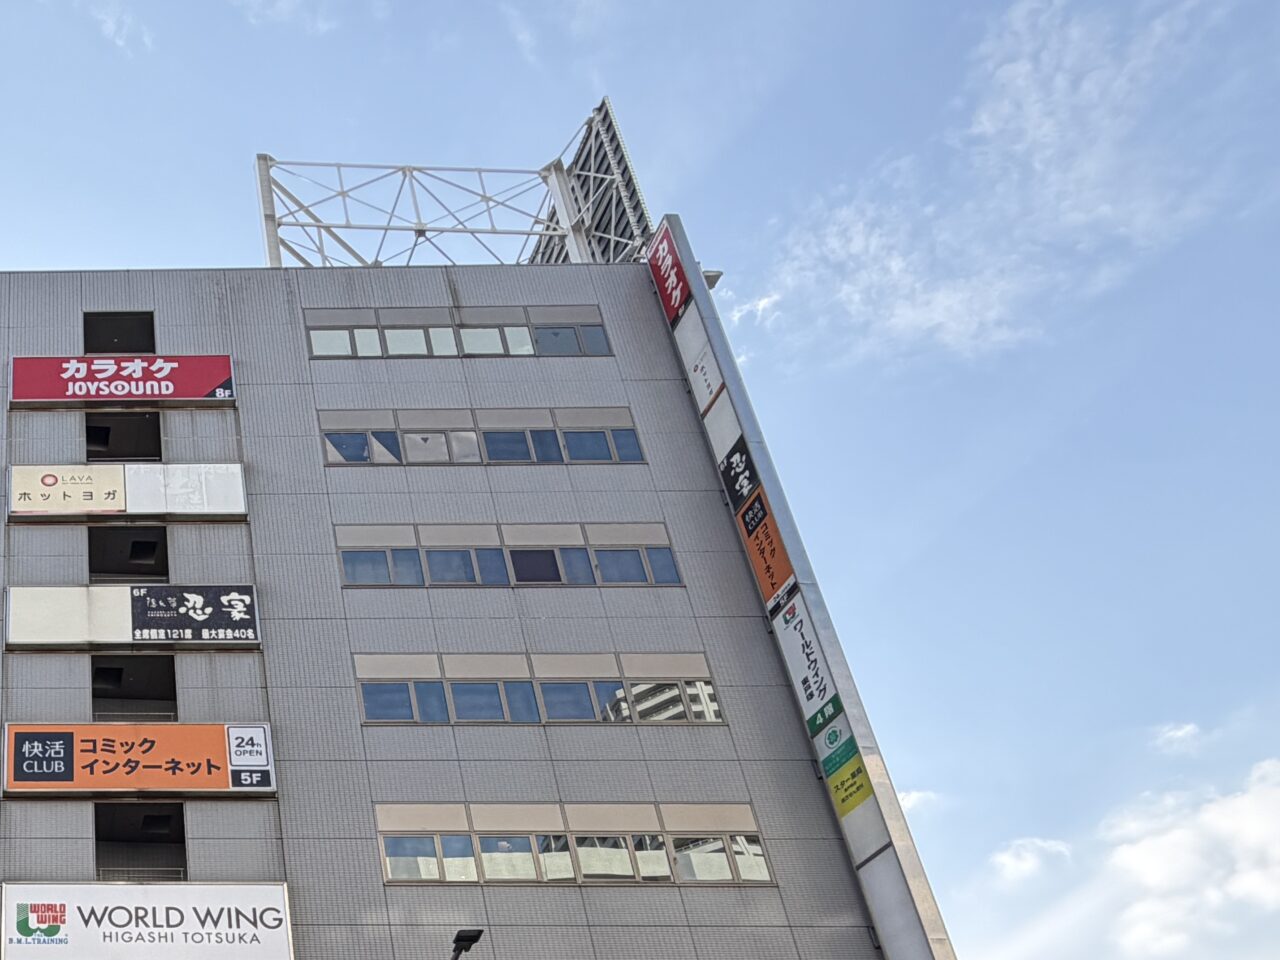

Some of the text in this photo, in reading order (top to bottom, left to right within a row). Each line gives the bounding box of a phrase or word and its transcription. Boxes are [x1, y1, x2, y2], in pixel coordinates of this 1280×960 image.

[656, 239, 683, 308] カラオケ
[60, 359, 178, 379] カラオケ
[65, 381, 174, 396] JOYSOUND
[215, 388, 231, 398] 8F
[18, 489, 117, 502] ホットヨガ
[80, 738, 156, 754] コミック
[235, 737, 262, 748] 24h
[22, 741, 65, 758] 快活
[23, 761, 65, 773] CLUB
[81, 758, 222, 776] インターネット
[240, 773, 262, 785] 5F
[29, 903, 66, 914] WORLD
[36, 914, 66, 924] WING
[77, 906, 283, 930] WORLD WING
[103, 931, 261, 944] HIGASHI TOTSUKA
